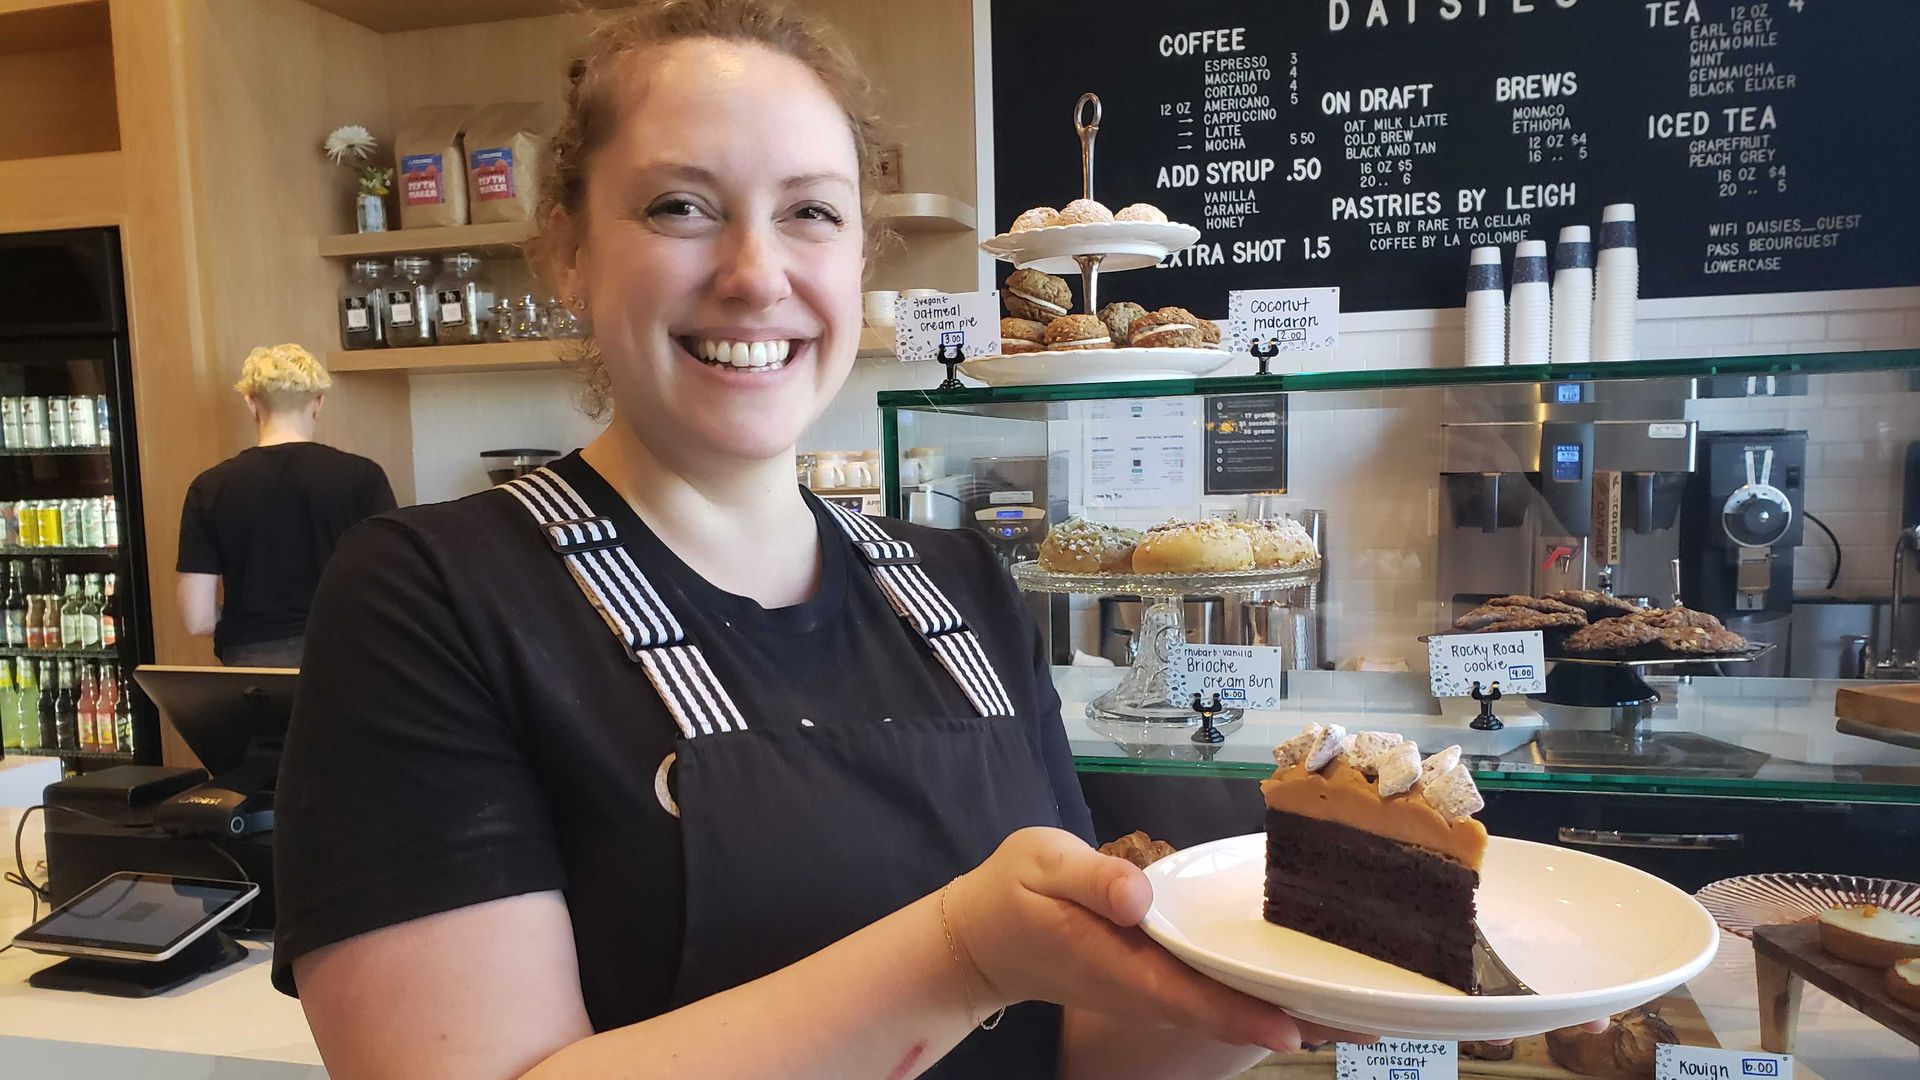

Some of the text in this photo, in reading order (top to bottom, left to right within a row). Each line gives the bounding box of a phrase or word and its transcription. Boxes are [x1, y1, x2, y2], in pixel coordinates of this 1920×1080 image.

[1329, 0, 1578, 31] DAIS
[1646, 0, 1701, 27] TEA
[1731, 6, 1745, 20] 12
[1750, 4, 1768, 18] OZ
[1690, 19, 1773, 39] EARL GREY
[1159, 27, 1246, 56] COFFEE
[1690, 32, 1778, 53] CHAMOMILE
[1205, 53, 1298, 71] ESPRESSO 3
[1690, 52, 1724, 68] MINT
[1205, 66, 1298, 85] MACCHIATO 4
[1689, 63, 1774, 82] GENMAICHA
[1204, 80, 1298, 98] CORTADO 4
[1496, 72, 1577, 101] BREWS
[1689, 75, 1796, 97] BLACK ELIXER
[1160, 93, 1298, 115] 12 OZ AMERICANO 5
[1321, 84, 1433, 114] ON DRAFT
[1203, 109, 1277, 125] CAPPUCCINO
[1513, 105, 1565, 119] MONACO
[1344, 114, 1448, 133] OAT MILK LATTE
[1513, 119, 1571, 134] ETHIOPIA
[1648, 105, 1777, 139] ICED TEA
[1206, 125, 1241, 138] LATTE
[1345, 130, 1413, 146] COLD BREW
[1205, 138, 1246, 151] MOCHA
[1529, 133, 1587, 149] 12 OZ $4
[1689, 135, 1770, 154] GRAPEFRUIT
[1346, 142, 1436, 159] BLACK AND TAN
[1529, 150, 1542, 163] 16
[1580, 148, 1588, 160] 5
[1689, 149, 1776, 168] PEACH GREY
[1156, 157, 1322, 188] ADD SYRUP .50
[1360, 159, 1413, 174] 16 OZ $5
[1718, 166, 1786, 182] 16 OZ $4
[1403, 173, 1411, 185] 6
[1204, 189, 1256, 204] VANILLA
[1719, 184, 1737, 196] 20
[1778, 180, 1786, 192] 5
[1204, 202, 1260, 217] CARAMEL
[1331, 182, 1576, 220] PASTRIES BY LEIGH
[1206, 216, 1245, 230] HONEY
[1369, 214, 1531, 235] TEA BY RARE TEA CELLAR
[1709, 223, 1738, 237] WIFI
[1370, 230, 1528, 251] COFFEE BY LA COLOMBE
[1707, 233, 1840, 257] PASS BEOURGUEST
[1232, 239, 1286, 263] SHOT
[1303, 236, 1331, 260] 1.5
[1704, 257, 1782, 274] LOWERCASE
[914, 304, 960, 319] oatmeal
[920, 317, 977, 331] cream pie
[1254, 316, 1319, 331] macaron
[1281, 330, 1301, 339] 2.00
[1187, 657, 1237, 673] Brioche
[1249, 675, 1273, 688] Bun
[1367, 1056, 1427, 1067] croissant
[1680, 1060, 1773, 1079] Kouign 6.00
